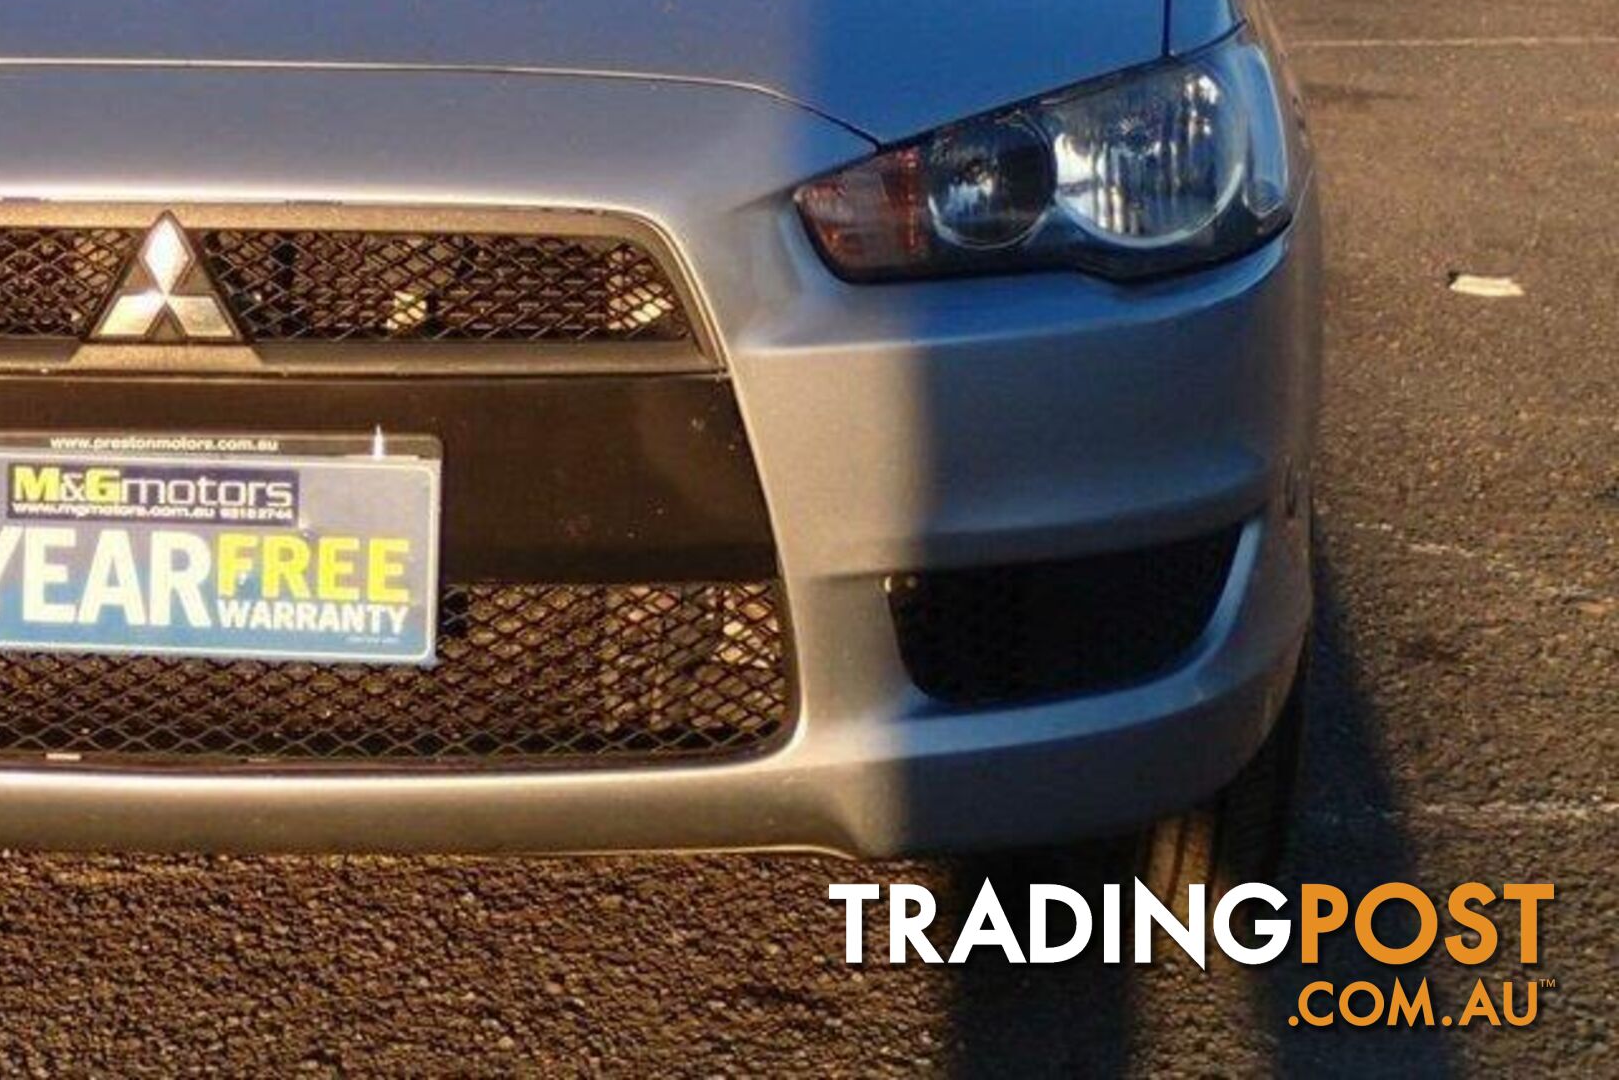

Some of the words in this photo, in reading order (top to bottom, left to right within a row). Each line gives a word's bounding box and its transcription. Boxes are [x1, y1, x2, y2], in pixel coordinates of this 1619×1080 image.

[49, 436, 279, 451] www.prestonmotors.com.au
[217, 532, 410, 602] FREE
[216, 598, 409, 634] WARRANTY
